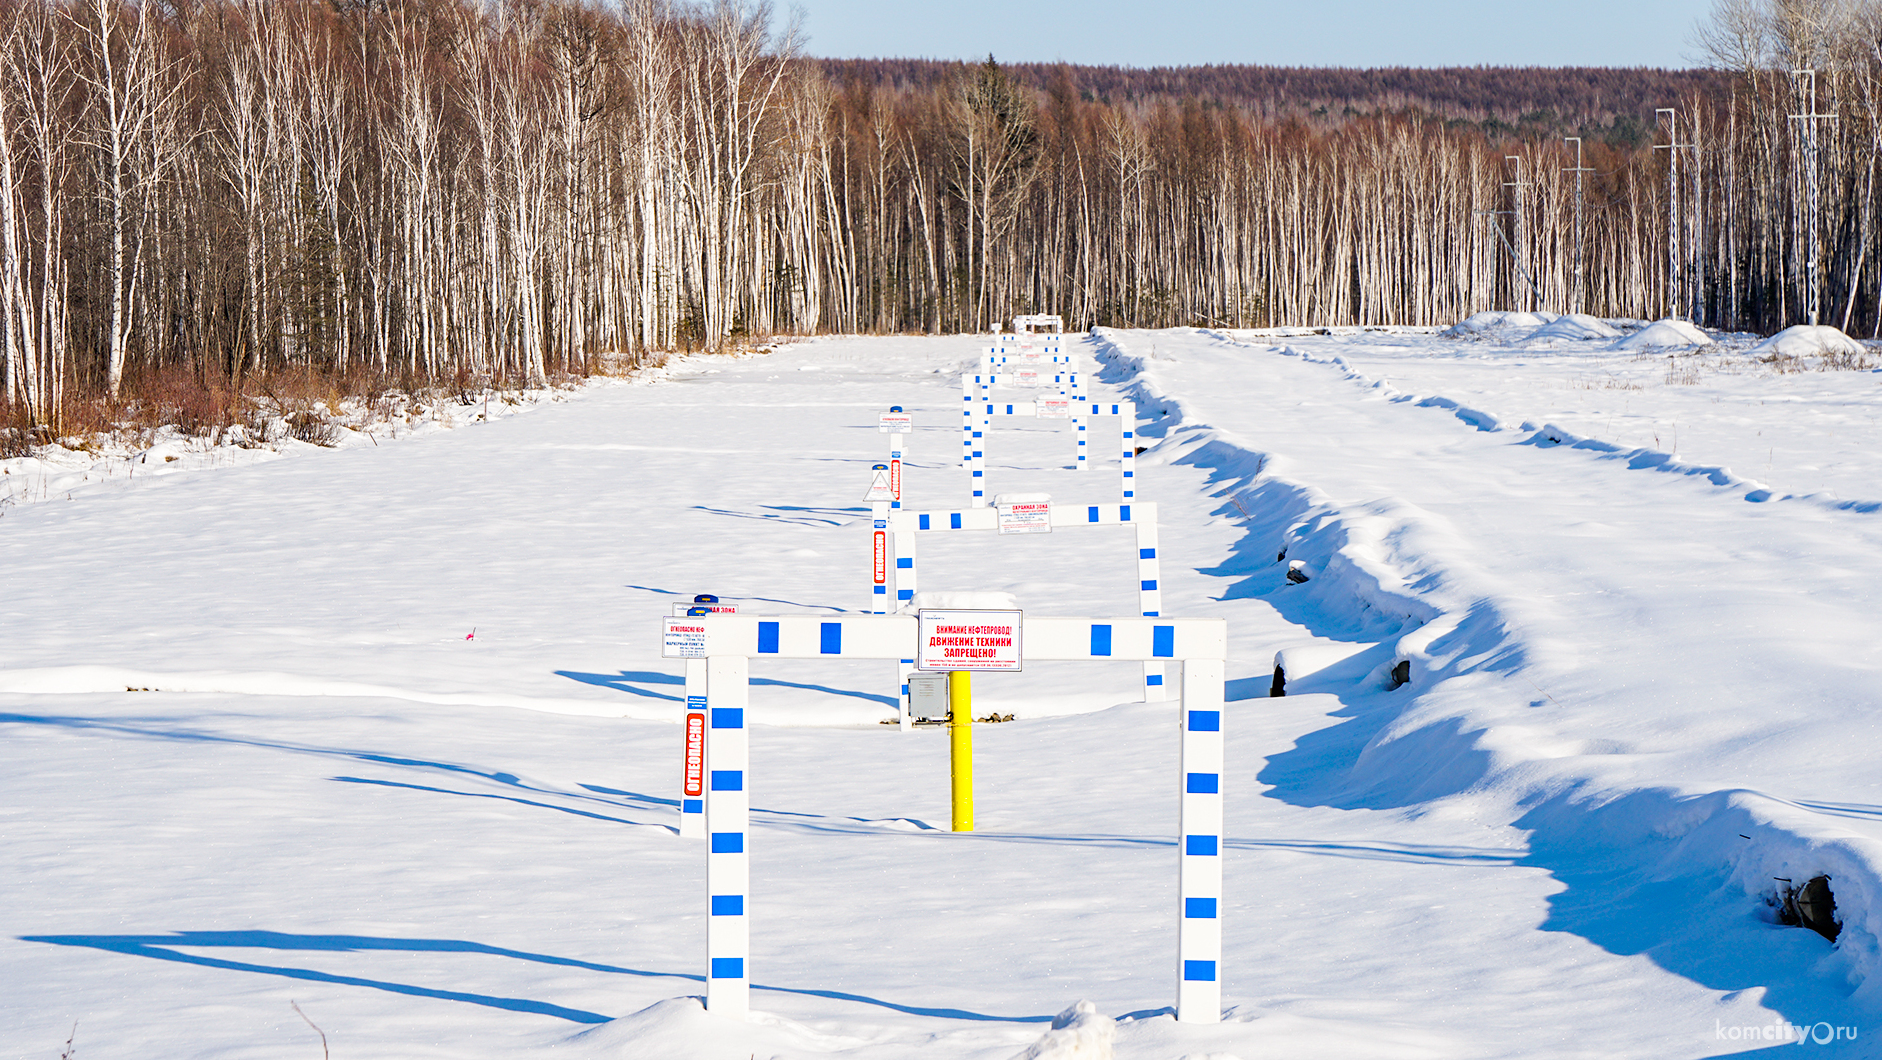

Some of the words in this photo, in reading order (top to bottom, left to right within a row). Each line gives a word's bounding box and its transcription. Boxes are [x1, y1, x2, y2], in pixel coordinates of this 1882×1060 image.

[875, 534, 884, 580] ОГНЕОПАСНО
[936, 625, 967, 634] ВНИМАНИЕ
[968, 625, 1012, 636] НЕФТЕПРОВОД!
[929, 636, 974, 647] ДВИЖЕНИЕ
[975, 637, 1012, 647] ТЕХНИКИ
[944, 648, 996, 658] ЗАПРЕЩЕНО!
[687, 718, 702, 791] ОГНЕОПАСНО
